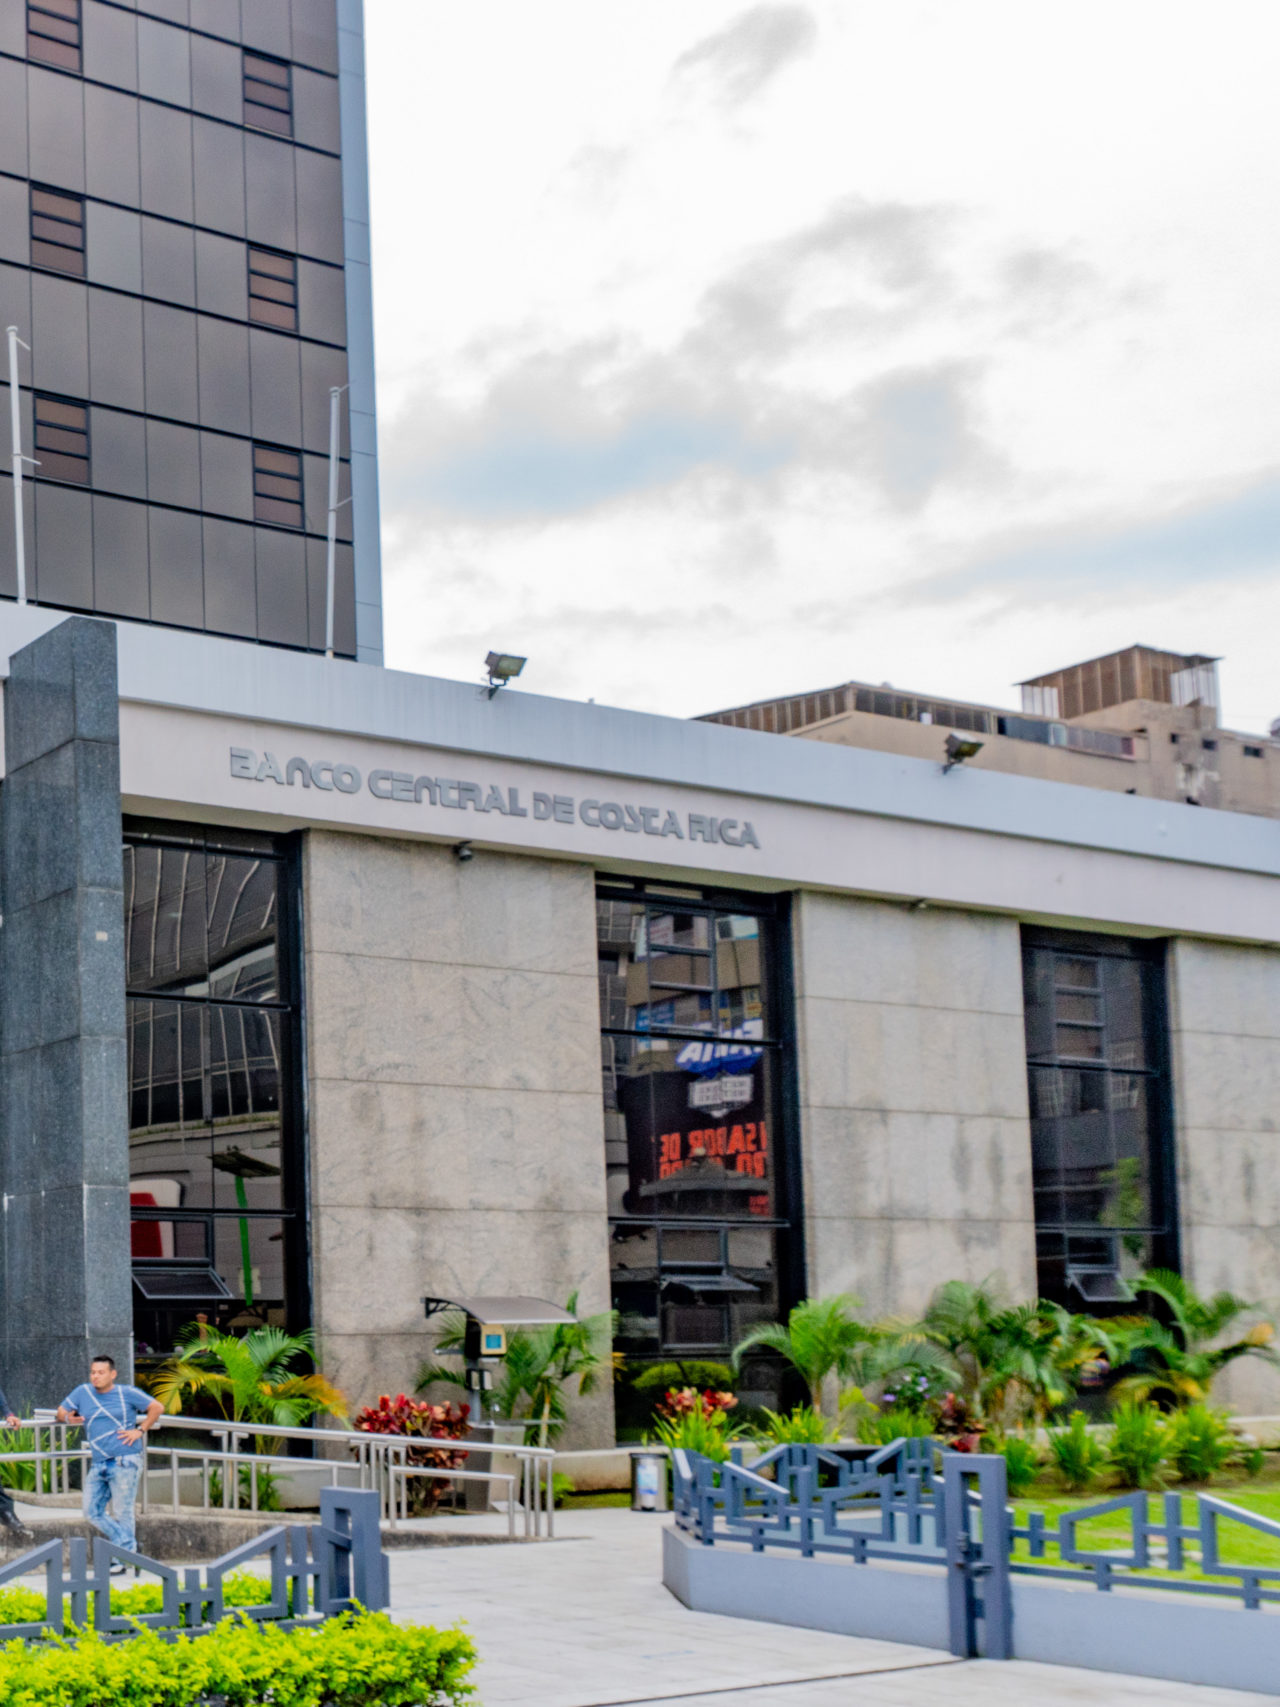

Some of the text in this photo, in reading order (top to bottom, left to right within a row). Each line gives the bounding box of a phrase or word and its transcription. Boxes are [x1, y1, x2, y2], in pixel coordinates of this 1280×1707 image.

[230, 747, 760, 849] BANCO CENTRAL DE COSTA RICA
